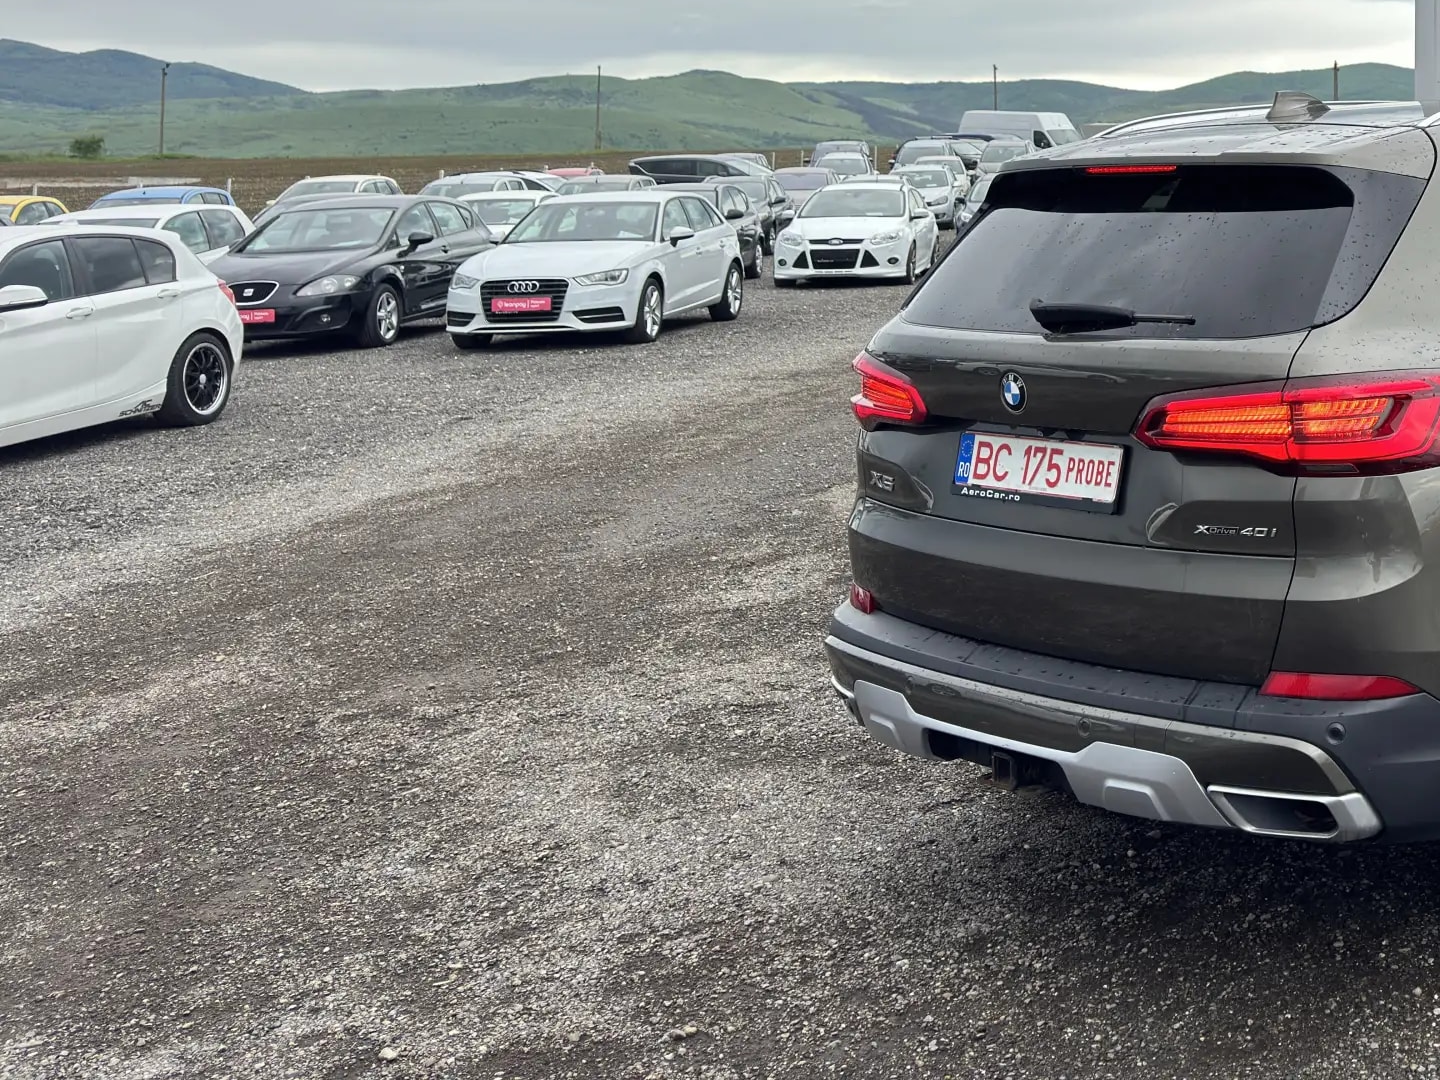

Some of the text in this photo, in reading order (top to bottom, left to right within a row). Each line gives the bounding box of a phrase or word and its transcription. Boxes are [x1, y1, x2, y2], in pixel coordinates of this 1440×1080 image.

[957, 440, 1116, 489] RO BC 175 PROBE
[869, 470, 896, 492] X5
[960, 486, 1021, 502] AeroCar.ro
